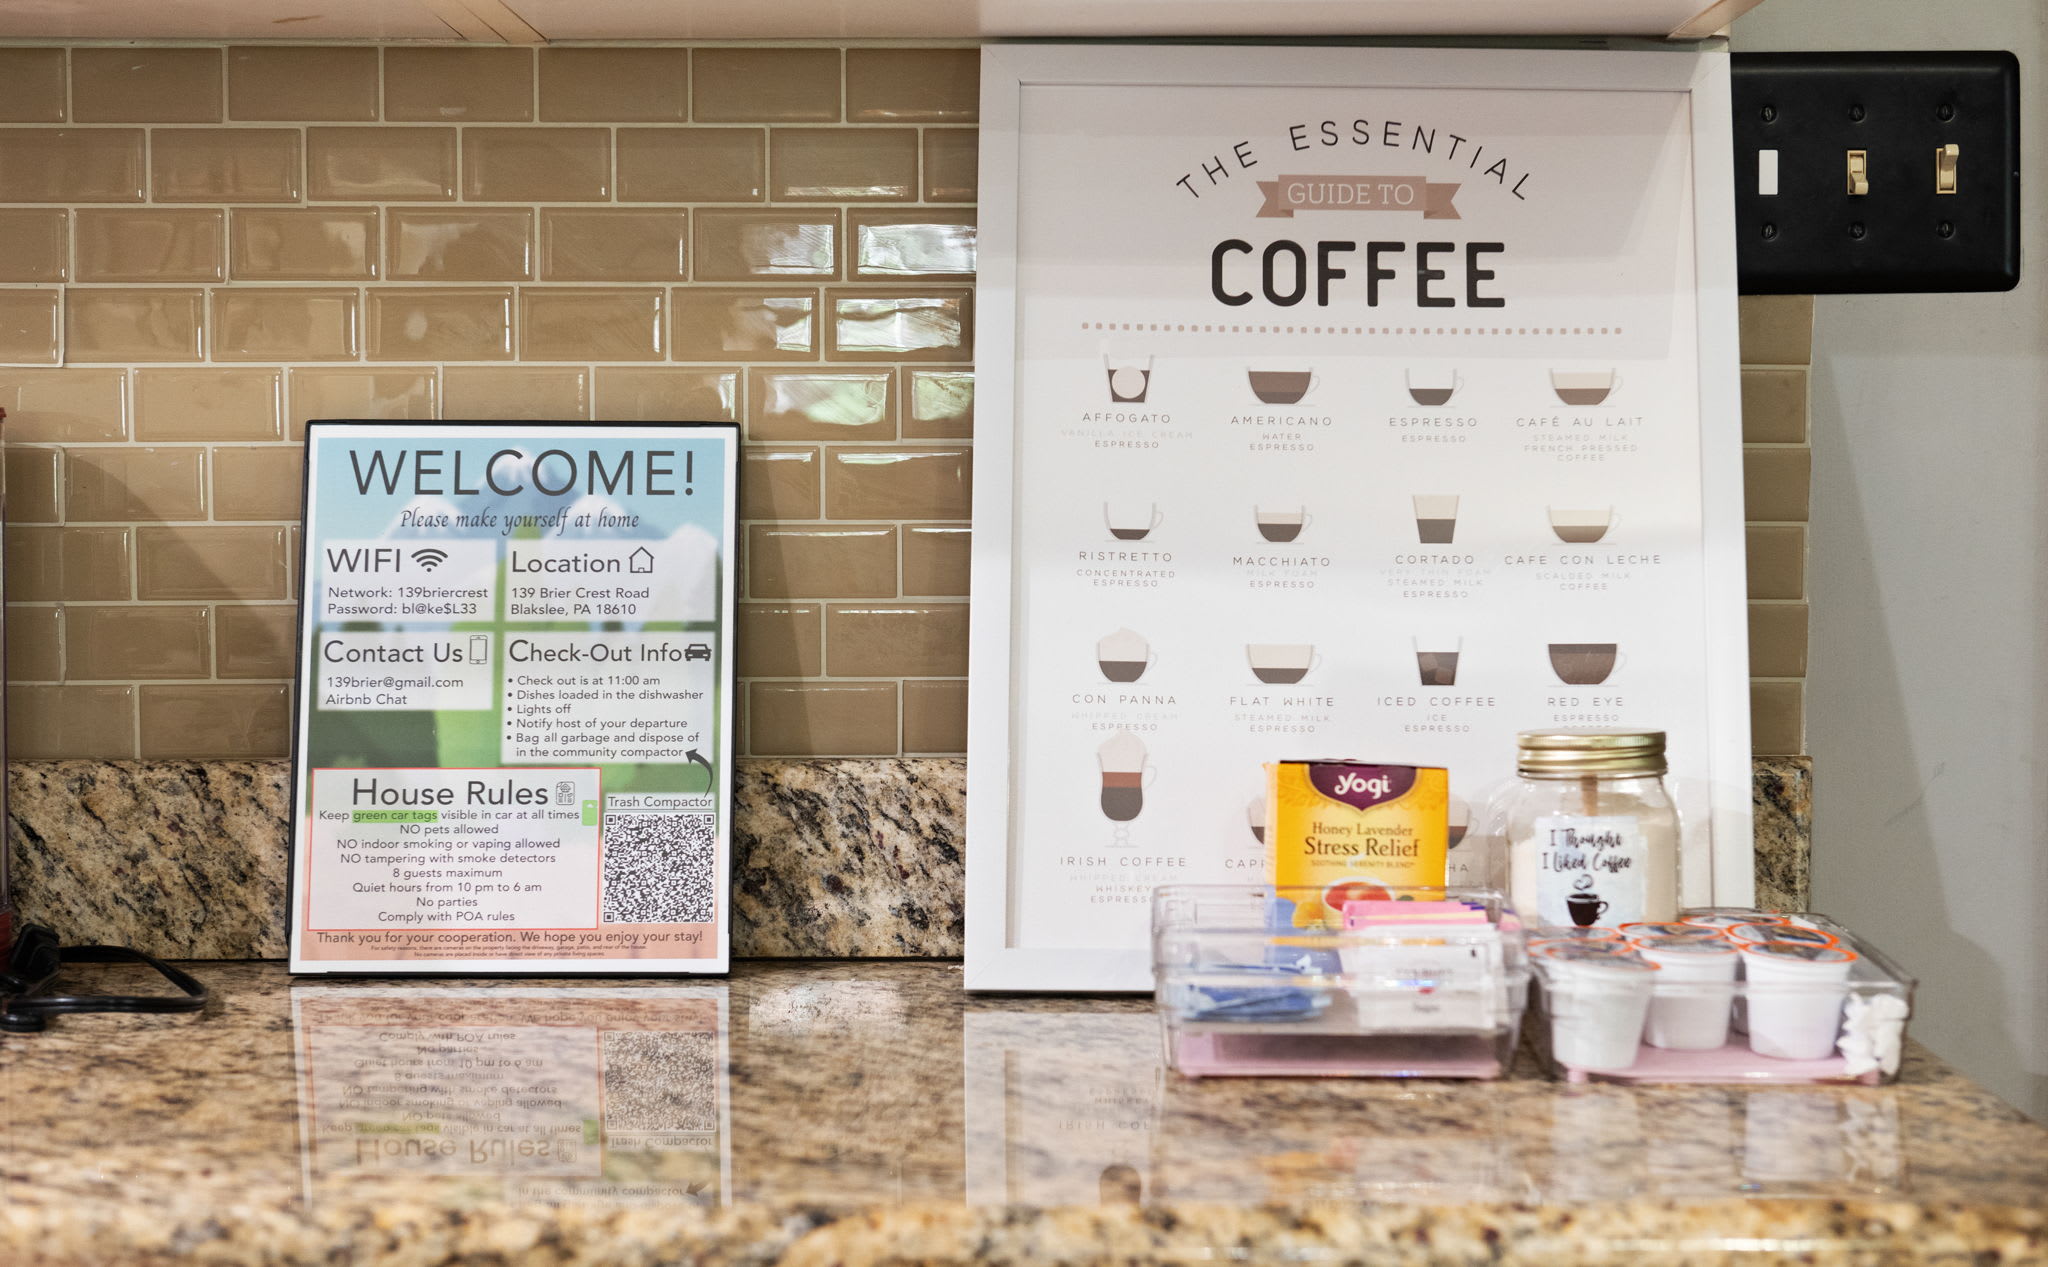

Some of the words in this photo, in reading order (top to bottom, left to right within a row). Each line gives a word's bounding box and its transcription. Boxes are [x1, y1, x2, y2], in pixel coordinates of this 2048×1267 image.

[1176, 140, 1258, 199] THE
[1289, 119, 1530, 201] ESSENTIAL
[1287, 183, 1371, 206] GUIDE
[1377, 183, 1415, 206] TO
[1211, 239, 1506, 308] COFFEE
[1082, 411, 1171, 424] AFFOGATO
[1230, 415, 1332, 426] AMERICANO
[1389, 417, 1477, 428] ESPRESSO
[1572, 417, 1593, 427] AU
[1606, 416, 1643, 427] LAIT
[1262, 432, 1305, 442] WATER
[1401, 434, 1466, 443] ESPRESSO
[349, 449, 693, 497] WELCOME!
[401, 509, 449, 529] Please
[455, 506, 498, 528] make
[502, 506, 573, 537] yourself
[574, 514, 592, 529] at
[597, 506, 640, 529] home
[327, 548, 400, 573] WIFI
[512, 551, 620, 573] Location
[1079, 550, 1172, 562] RISTRETTO
[1233, 556, 1330, 567] MACCHIATO
[1395, 554, 1474, 565] CORTADO
[1504, 555, 1547, 565] CAFE
[1560, 555, 1594, 565] CON
[1607, 553, 1661, 565] LECHE
[1076, 569, 1175, 578] CONCENTRATED
[329, 586, 392, 598] Network:
[398, 586, 488, 598] 139briercrest
[512, 587, 536, 599] 139
[540, 587, 572, 599] Brier
[575, 587, 611, 599] Crest
[616, 587, 650, 598] Road
[328, 603, 398, 615] Password:
[511, 603, 568, 616] Blakslee,
[574, 603, 591, 615] PA
[596, 603, 637, 615] 18610
[324, 640, 424, 663] Contact
[434, 643, 463, 663] Us
[509, 639, 632, 662] Check-Out
[641, 642, 682, 662] Info
[327, 676, 464, 690] 139brier@gmail.com
[517, 675, 553, 686] Check
[556, 677, 576, 686] out
[580, 675, 589, 686] is
[592, 677, 604, 686] at
[608, 675, 640, 686] 11:00
[643, 678, 660, 686] am
[325, 693, 372, 705] Airbnb
[376, 693, 408, 705] Chat
[517, 689, 555, 700] Dishes
[558, 689, 599, 700] loaded
[602, 690, 613, 700] in
[616, 689, 635, 700] the
[638, 689, 704, 700] dishwasher
[1072, 693, 1106, 705] CON
[1119, 694, 1176, 705] PANNA
[1230, 696, 1270, 706] FLAT
[1283, 697, 1334, 707] WHITE
[1377, 696, 1416, 707] ICED
[1429, 696, 1495, 707] COFFEE
[1547, 697, 1580, 707] RED
[1593, 696, 1623, 707] EYE
[517, 704, 552, 716] Lights
[555, 703, 572, 714] off
[516, 717, 553, 731] Notify
[556, 718, 581, 728] host
[585, 717, 597, 728] of
[600, 721, 627, 731] your
[629, 718, 688, 732] departure
[516, 732, 540, 746] Bag
[544, 732, 557, 743] all
[561, 732, 610, 746] garbage
[613, 732, 635, 743] and
[639, 732, 684, 746] dispose
[687, 732, 700, 742] of
[516, 747, 526, 757] in
[529, 746, 549, 757] the
[552, 747, 618, 760] community
[620, 748, 684, 760] compactor
[353, 778, 454, 806] House
[467, 779, 548, 805] Rules
[608, 795, 640, 807] Trash
[643, 795, 713, 809] Compactor
[319, 810, 350, 824] Keep
[353, 812, 388, 823] green
[391, 812, 409, 820] car
[412, 811, 438, 823] tags
[441, 809, 478, 820] visible
[481, 810, 492, 820] in
[495, 812, 513, 820] car
[516, 811, 528, 820] at
[531, 809, 544, 820] all
[547, 809, 580, 820] times
[400, 824, 421, 835] NO
[424, 826, 450, 838] pets
[453, 824, 499, 834] allowed
[1311, 822, 1353, 838] Honey
[1356, 822, 1414, 837] Lavender
[337, 838, 358, 849] NO
[361, 838, 400, 849] indoor
[403, 838, 453, 852] smoking
[456, 841, 469, 849] or
[472, 838, 512, 852] vaping
[514, 838, 560, 848] allowed
[1304, 836, 1359, 856] Stress
[1366, 837, 1419, 857] Relief
[340, 853, 362, 864] NO
[364, 853, 426, 867] tampering
[429, 853, 454, 863] with
[458, 853, 496, 863] smoke
[499, 852, 556, 863] detectors
[1060, 856, 1106, 867] IRISH
[1120, 856, 1185, 867] COFFEE
[392, 867, 400, 878] 8
[403, 869, 442, 881] guests
[446, 868, 503, 878] maximum
[352, 882, 386, 893] Quiet
[389, 882, 422, 892] hours
[425, 882, 453, 892] from
[458, 882, 472, 892] 10
[475, 884, 494, 895] pm
[497, 884, 510, 892] to
[513, 882, 521, 892] 6
[524, 884, 542, 892] am
[416, 897, 434, 907] No
[438, 897, 478, 910] parties
[378, 911, 424, 924] Comply
[427, 911, 452, 922] with
[456, 911, 484, 922] POA
[487, 910, 515, 921] rules
[317, 931, 355, 943] Thank
[358, 934, 382, 946] you
[385, 931, 402, 943] for
[406, 934, 435, 946] your
[438, 932, 516, 945] cooperation.
[520, 931, 541, 943] We
[544, 931, 576, 945] hope
[579, 934, 602, 945] you
[605, 931, 640, 945] enjoy
[642, 934, 671, 945] your
[674, 931, 703, 945] stay!
